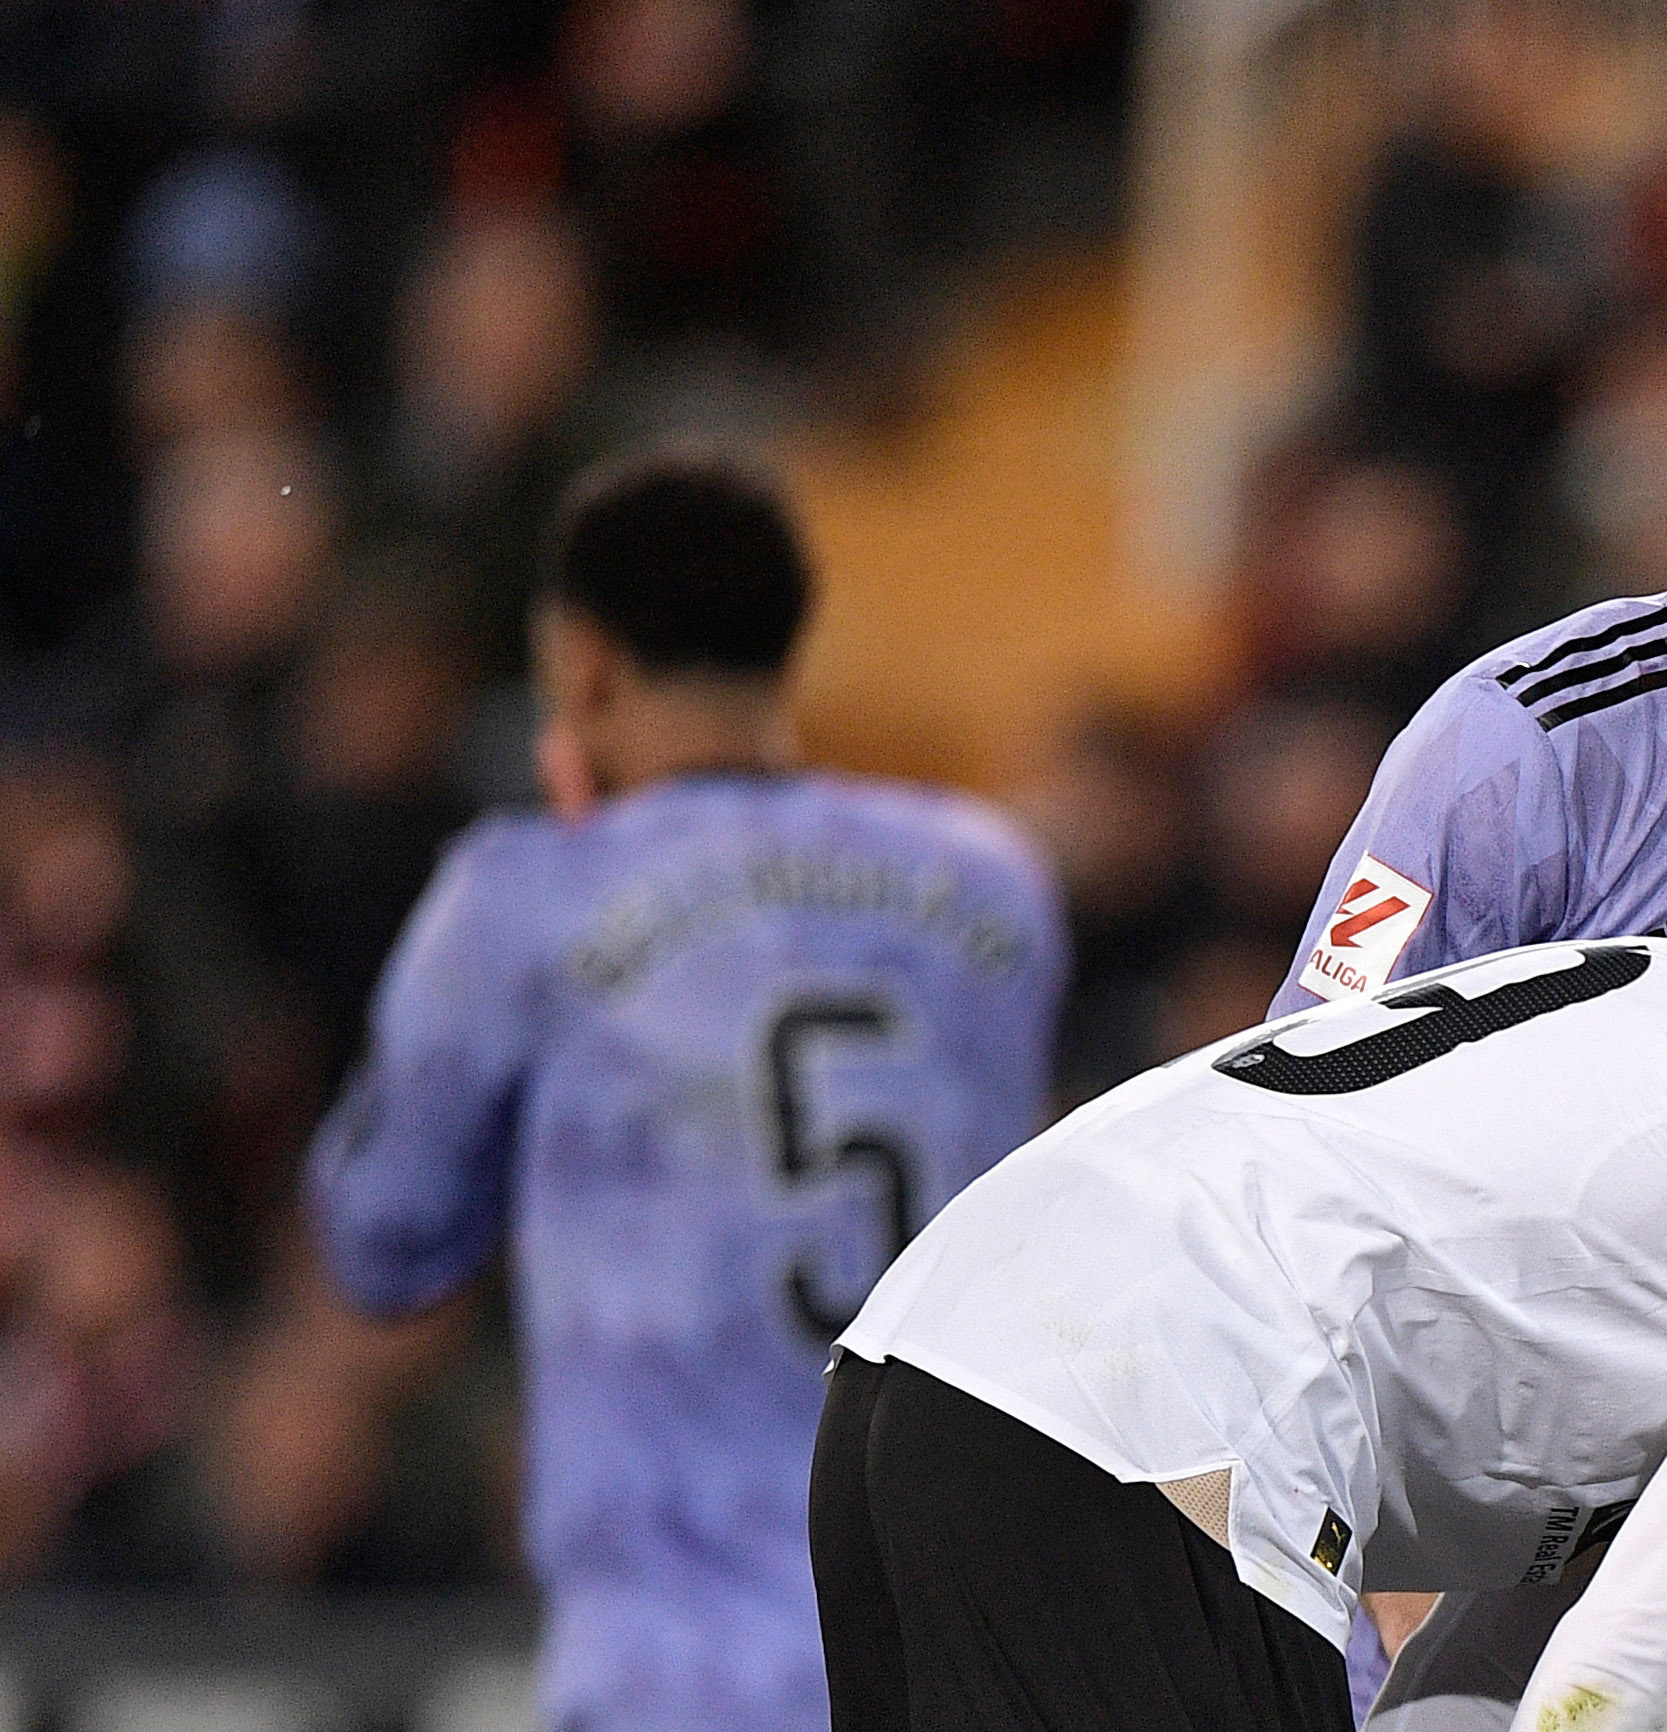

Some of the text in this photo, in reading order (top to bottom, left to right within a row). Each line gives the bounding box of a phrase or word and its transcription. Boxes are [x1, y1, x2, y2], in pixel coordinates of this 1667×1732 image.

[1309, 949, 1367, 993] ALIGA
[766, 998, 917, 1336] 5
[1534, 1535, 1569, 1563] Real
